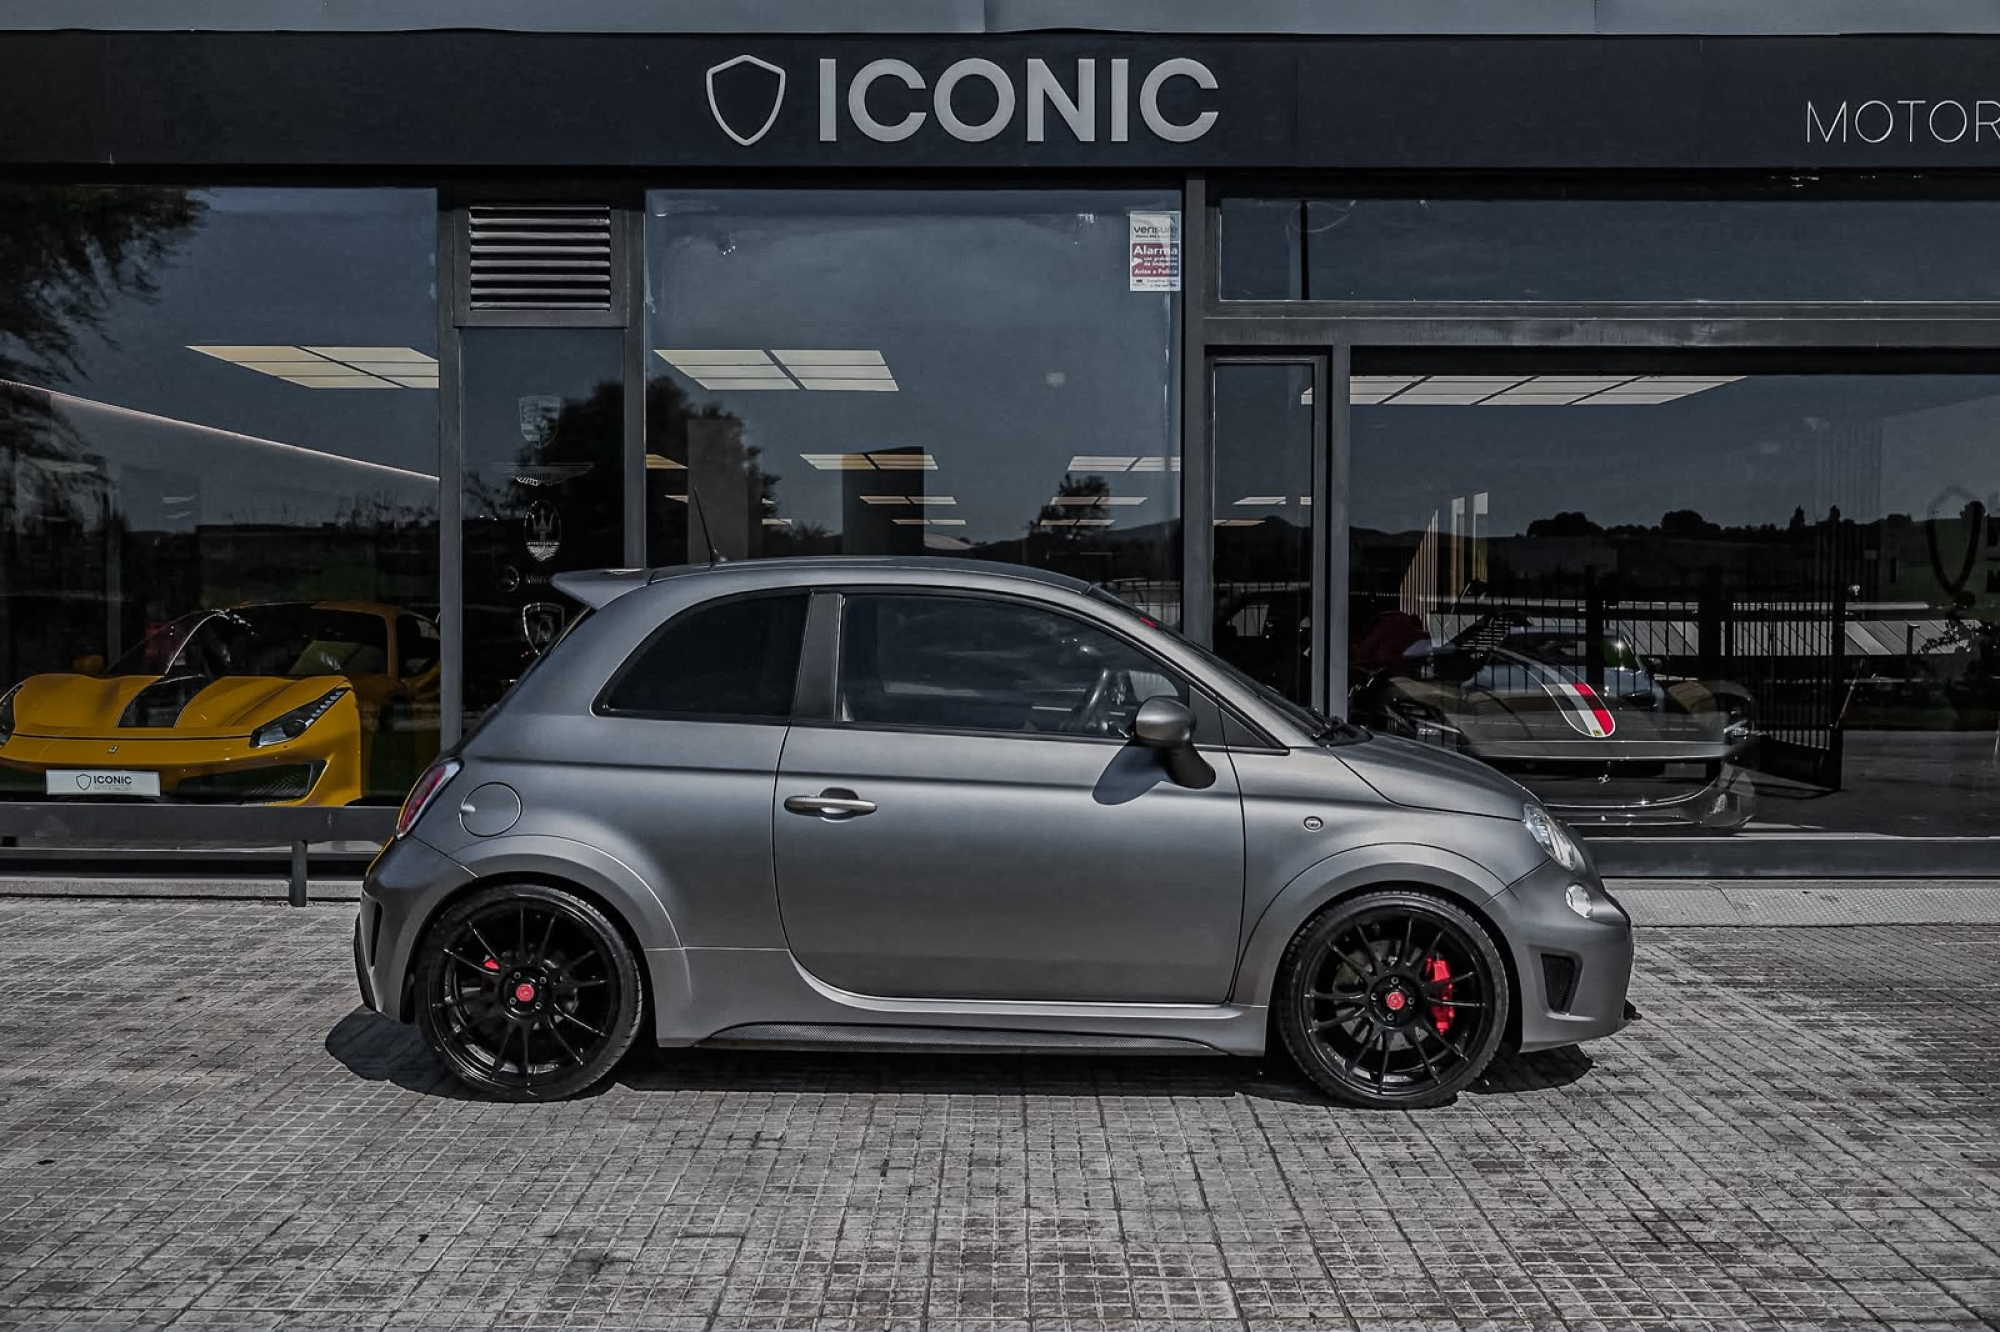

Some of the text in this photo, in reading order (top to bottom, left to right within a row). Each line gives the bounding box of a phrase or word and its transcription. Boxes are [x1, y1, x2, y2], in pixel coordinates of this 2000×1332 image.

[818, 57, 1220, 142] ICONIC
[1806, 100, 2000, 143] MOTOR
[1133, 245, 1178, 255] Alarma
[93, 775, 132, 785] ICONIC
